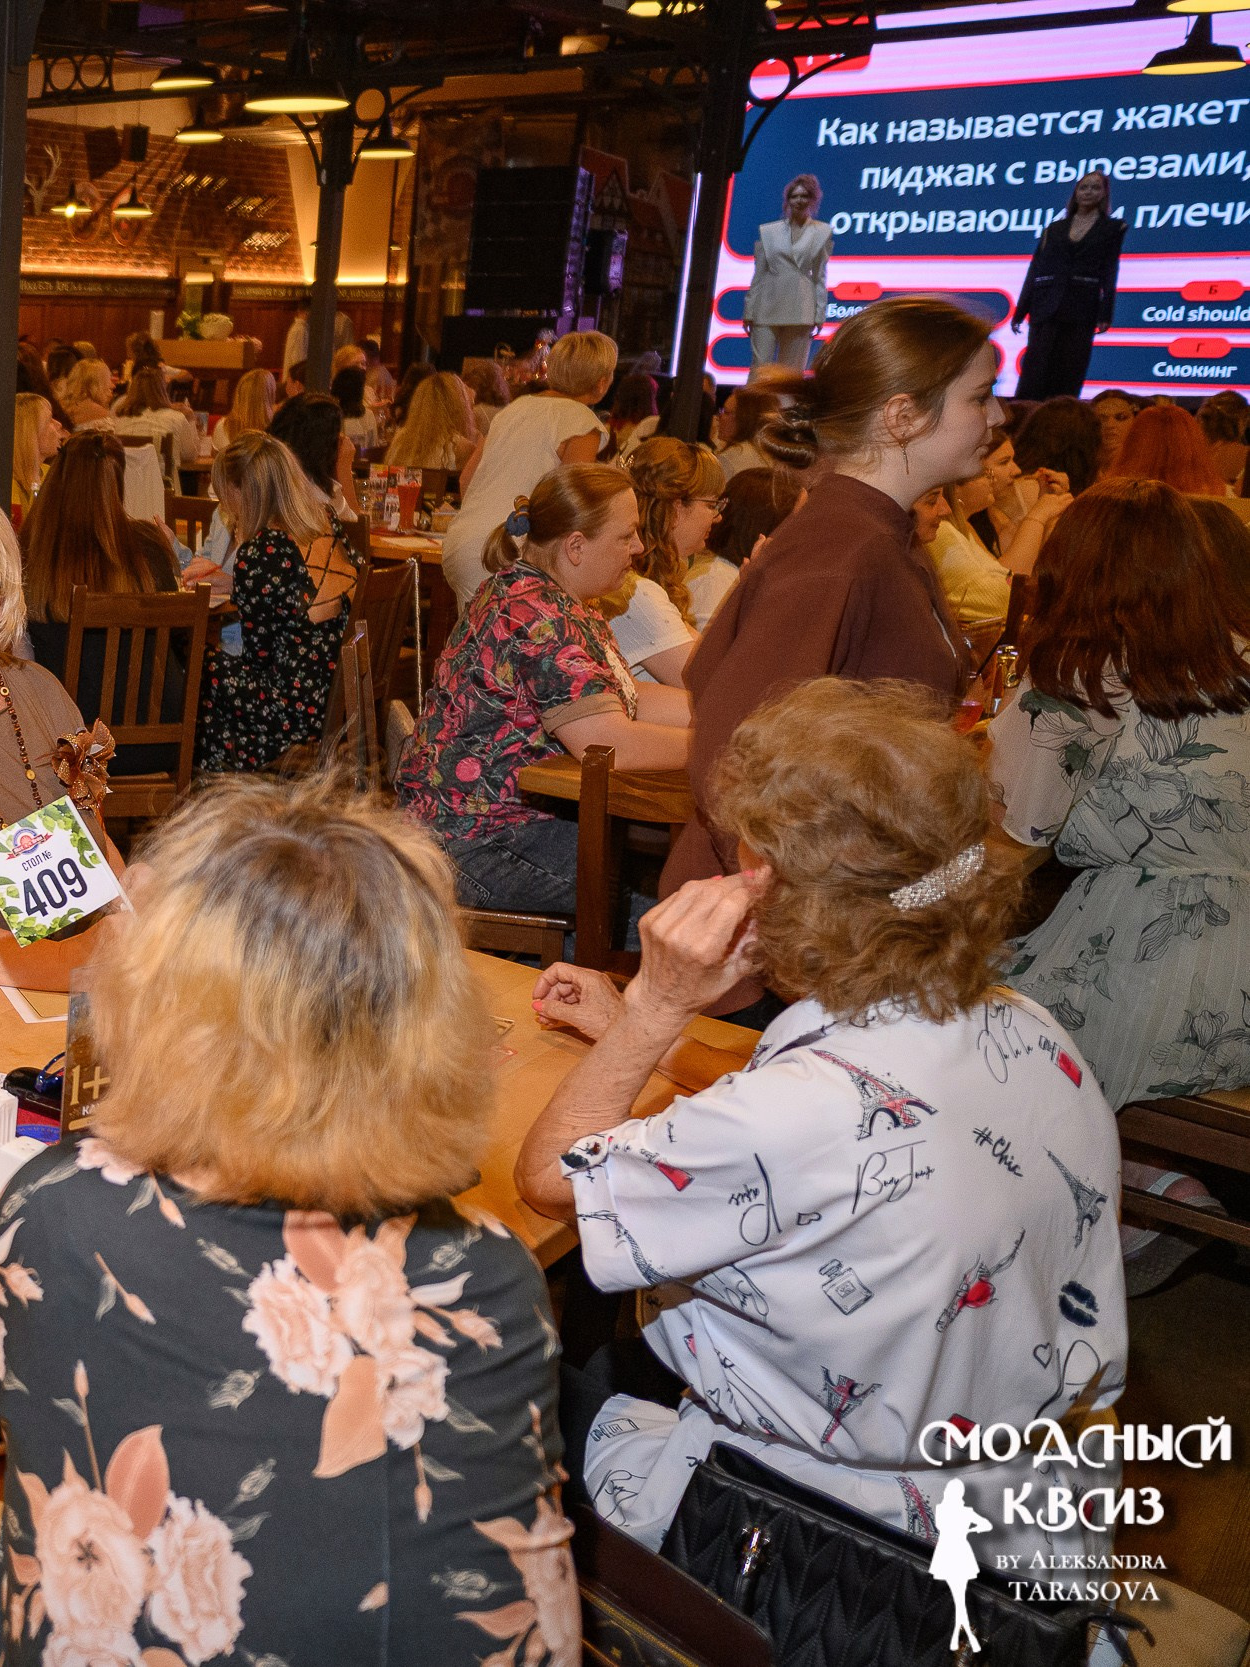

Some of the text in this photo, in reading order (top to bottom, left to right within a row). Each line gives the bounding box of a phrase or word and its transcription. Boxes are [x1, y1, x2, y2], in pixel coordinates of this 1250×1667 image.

[817, 98, 1250, 148] Как называется жакет
[860, 162, 998, 197] пиджак
[1005, 161, 1026, 186] с
[1208, 284, 1219, 295] Б
[1141, 305, 1186, 322] Cold
[1152, 361, 1238, 378] Смокинг
[21, 856, 43, 872] СТОЛ
[22, 857, 88, 917] 409
